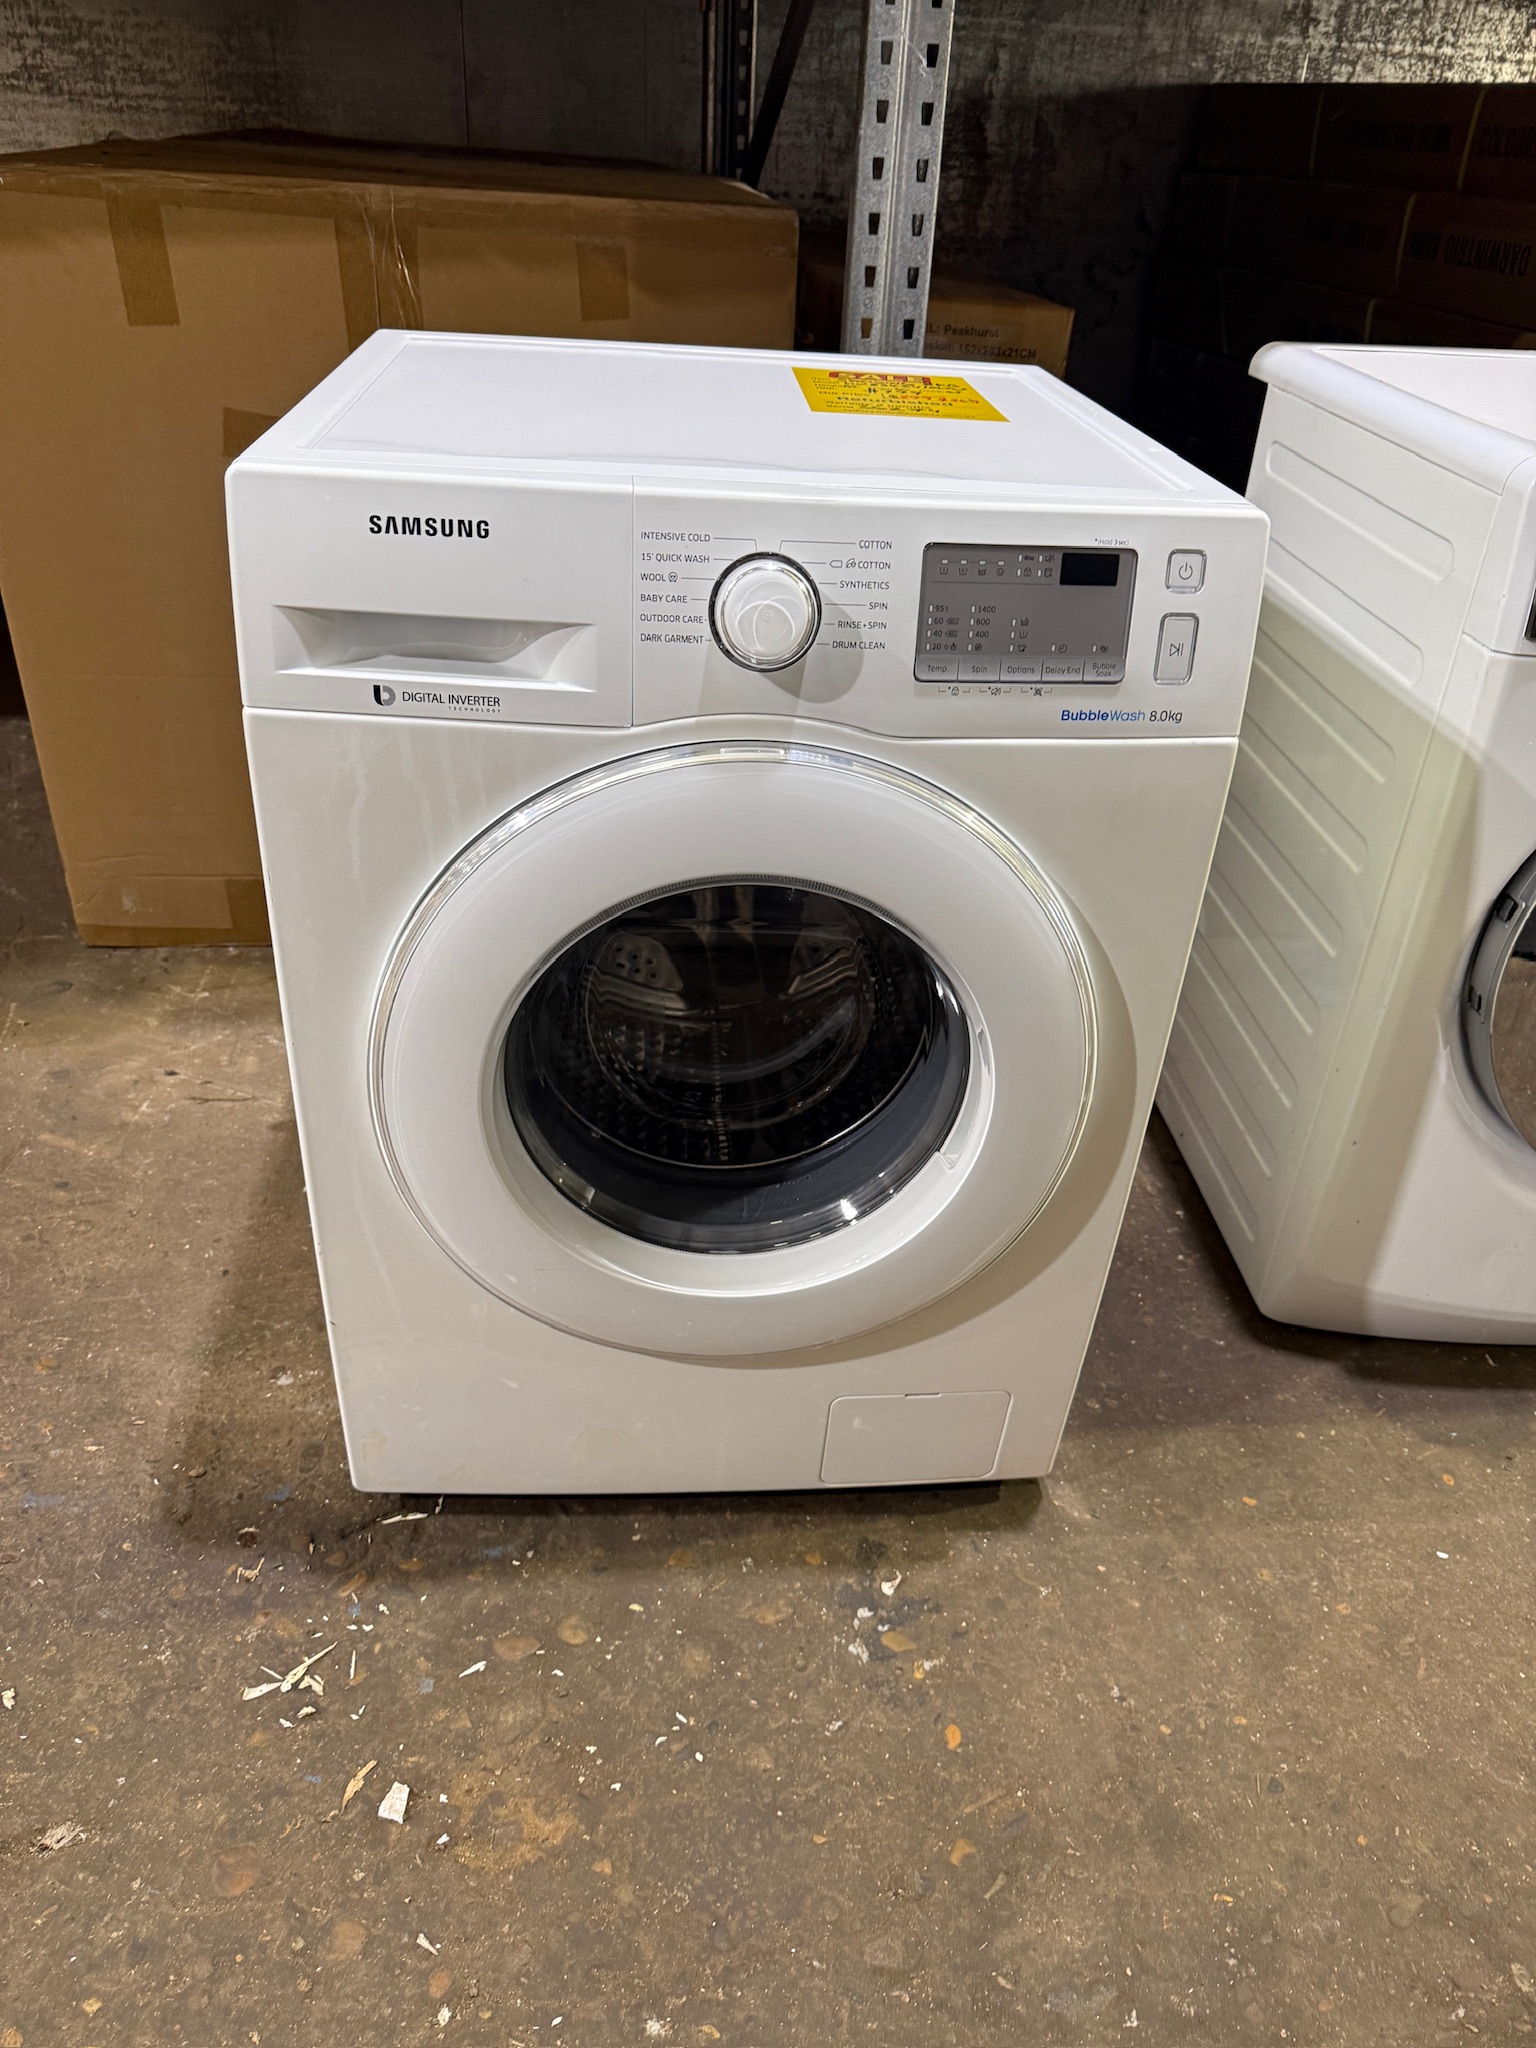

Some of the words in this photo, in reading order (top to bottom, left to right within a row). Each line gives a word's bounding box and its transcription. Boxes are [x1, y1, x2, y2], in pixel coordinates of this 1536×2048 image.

[944, 325, 999, 338] Peakhurst
[368, 514, 490, 539] SAMSUNG
[640, 531, 686, 542] INTENSIVE
[687, 532, 711, 543] COLD
[858, 539, 892, 550] COTTON
[655, 553, 682, 563] QUICK
[684, 555, 710, 563] WASH
[857, 560, 891, 570] COTTON
[640, 572, 666, 582] WOOL
[839, 580, 890, 590] SYNTHETICS
[640, 593, 664, 603] BABY
[665, 594, 688, 603] CARE
[868, 601, 888, 610] SPIN
[977, 605, 996, 613] 1400
[640, 614, 681, 623] OUTDOOR
[682, 615, 704, 624] CARE
[975, 618, 991, 626] 800
[837, 620, 862, 629] RINSE
[867, 621, 887, 630] SPIN
[640, 633, 663, 643] DARK
[664, 634, 704, 644] GARMENT
[832, 640, 857, 649] DRUM
[858, 641, 886, 650] CLEAN
[931, 643, 942, 651] 20
[971, 665, 988, 674] Spin
[1007, 666, 1035, 675] Options
[1045, 666, 1066, 676] Delay
[1066, 666, 1081, 675] End
[1092, 662, 1117, 671] Bubble
[1095, 670, 1112, 678] Soak
[402, 691, 445, 704] DIGITAL
[448, 694, 501, 708] INVERTER
[448, 705, 501, 714] TECHNOLOGY
[1061, 709, 1146, 721] BubbleWash
[1149, 709, 1183, 724] 8.0kg
